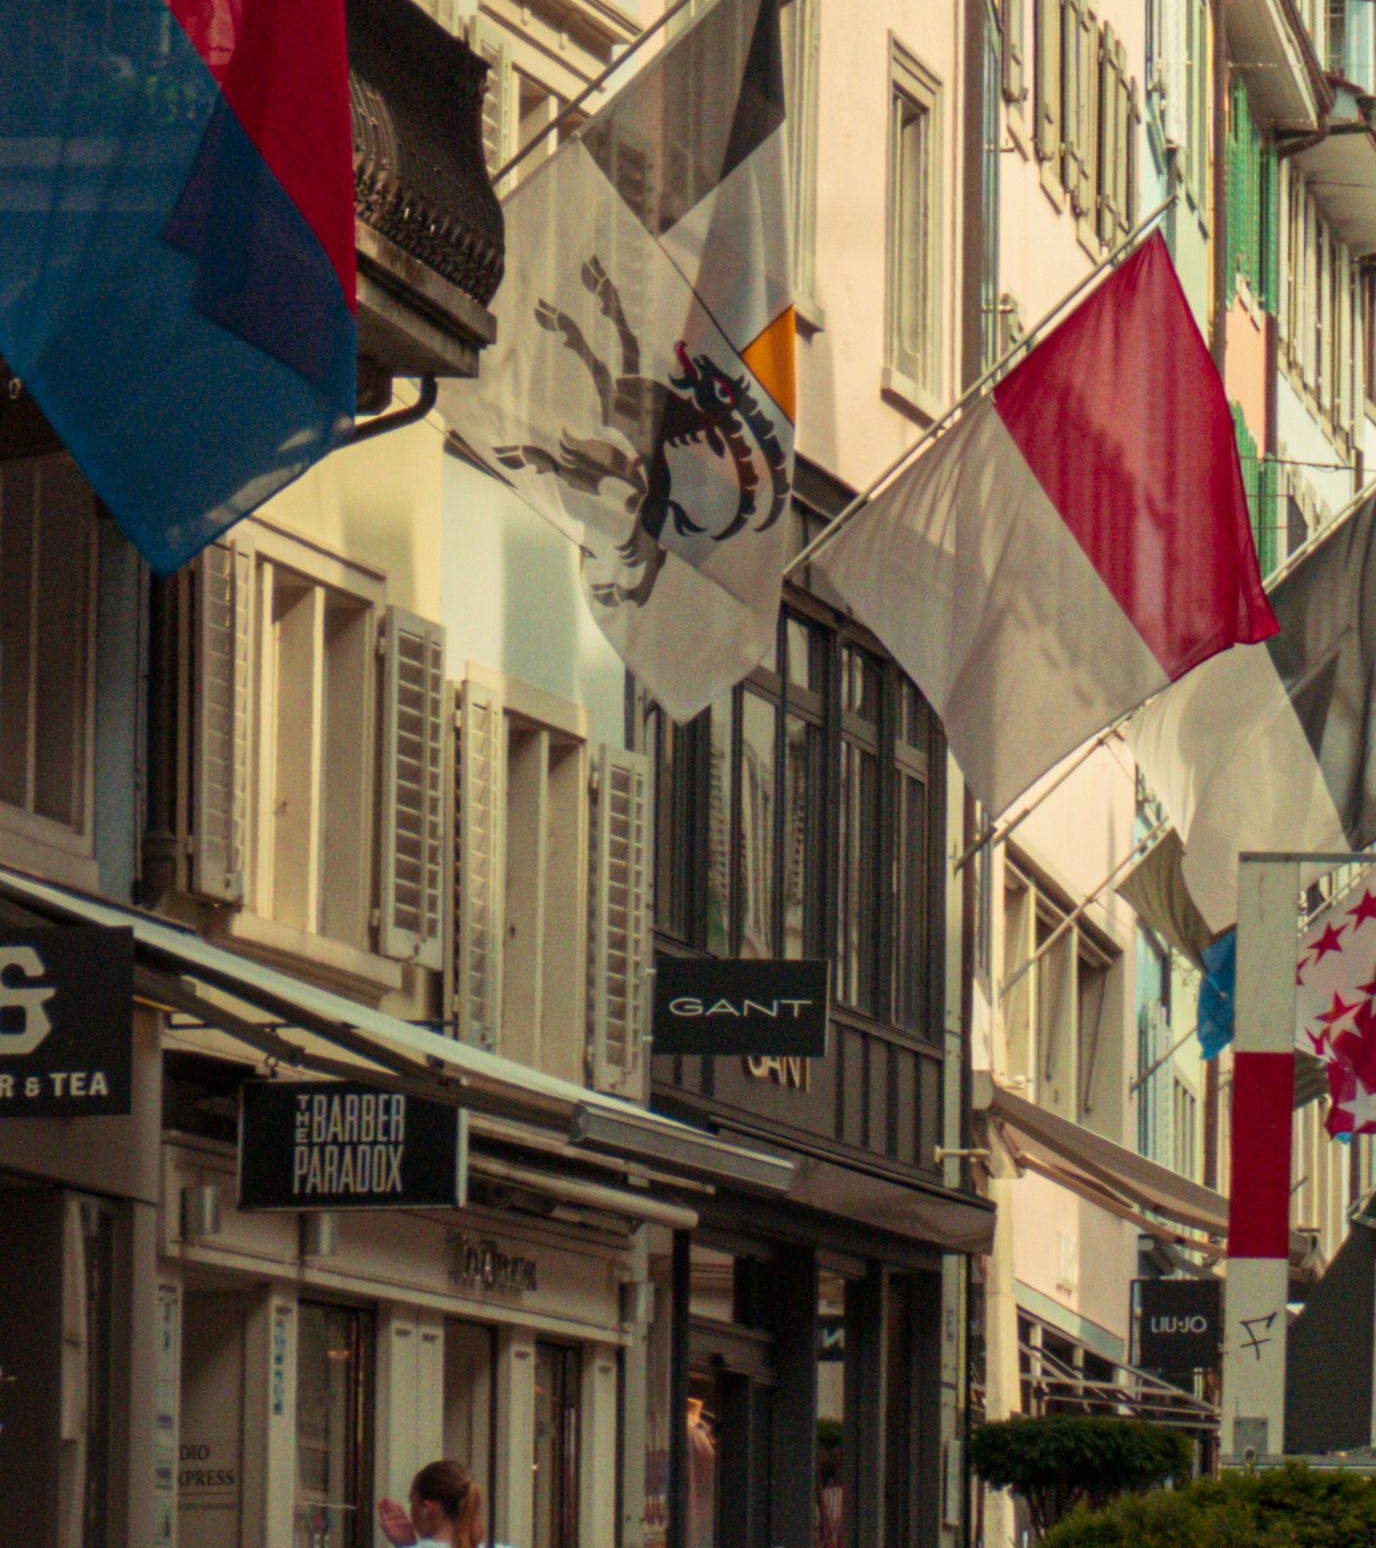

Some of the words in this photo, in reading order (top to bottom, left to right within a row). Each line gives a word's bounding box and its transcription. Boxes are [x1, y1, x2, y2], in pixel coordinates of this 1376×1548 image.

[669, 997, 813, 1018] GANT
[24, 1076, 41, 1097] &
[49, 1071, 109, 1097] TEA
[295, 1095, 311, 1143] THE
[312, 1094, 406, 1143] BARBER
[293, 1144, 405, 1194] PARADOX
[179, 1444, 211, 1462] DIO
